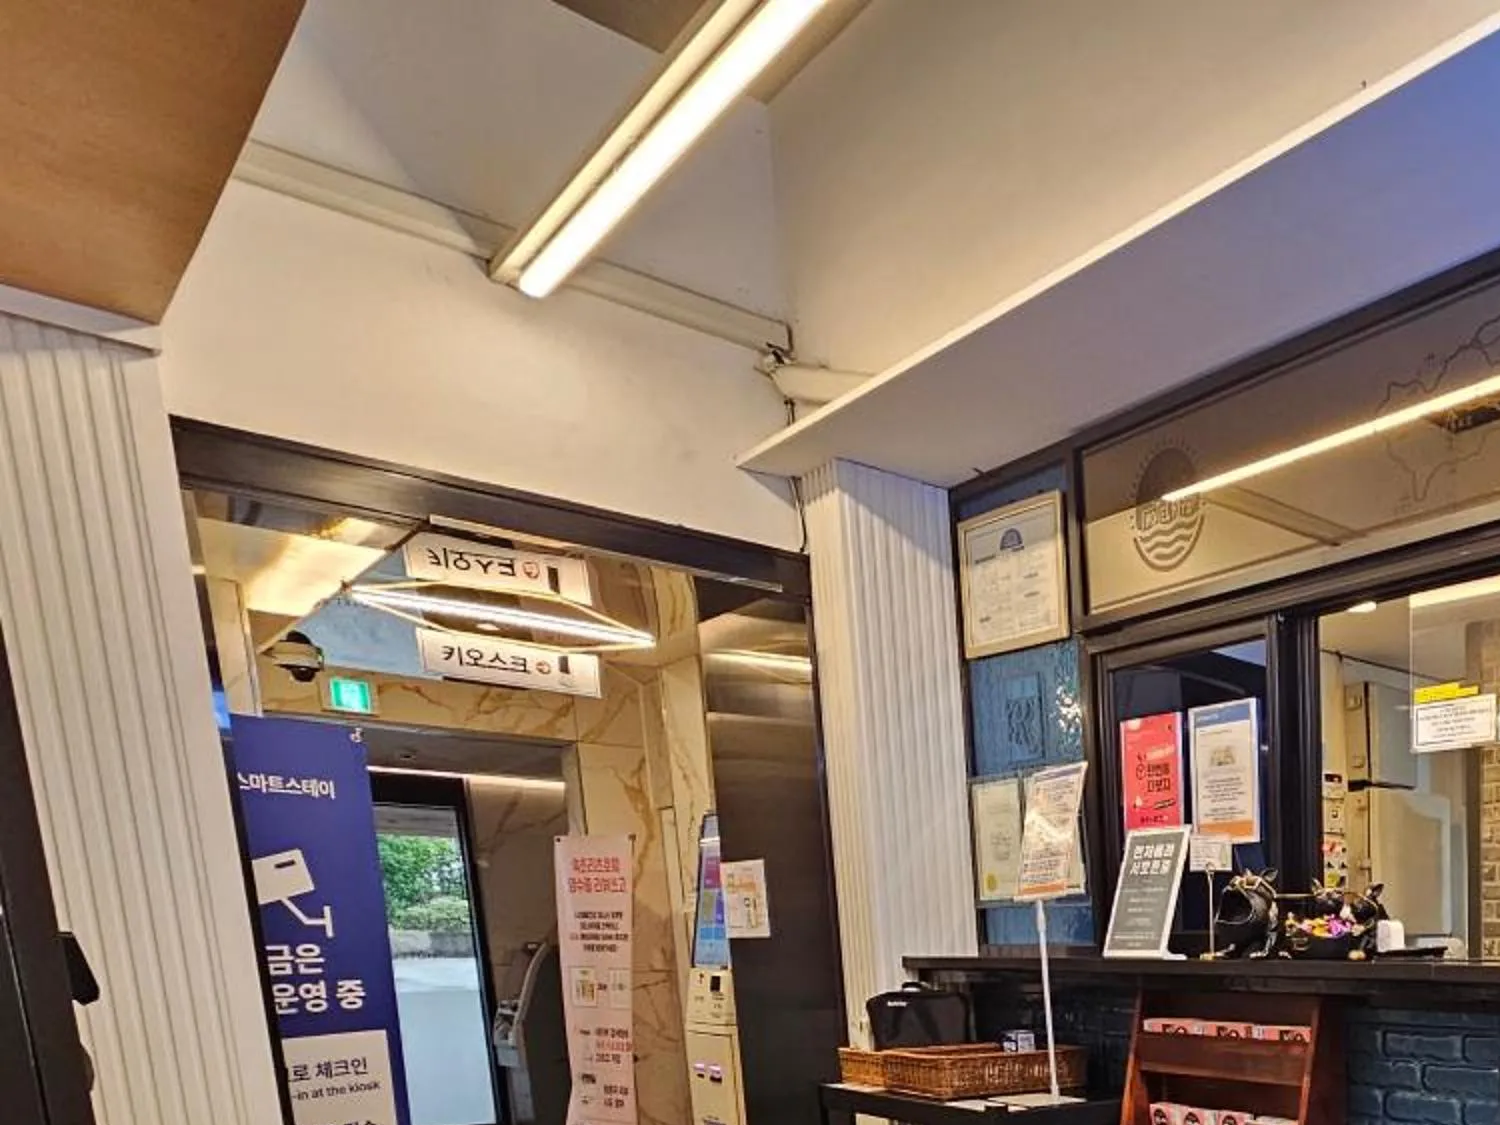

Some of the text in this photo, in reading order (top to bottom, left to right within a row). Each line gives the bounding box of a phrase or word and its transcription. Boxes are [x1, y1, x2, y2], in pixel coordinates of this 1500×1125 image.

[442, 645, 531, 674] 키오스크
[337, 978, 367, 1010] 중
[316, 1057, 368, 1079] 체크인
[312, 1086, 324, 1099] at
[326, 1084, 346, 1097] the
[349, 1080, 381, 1095] kiosk
